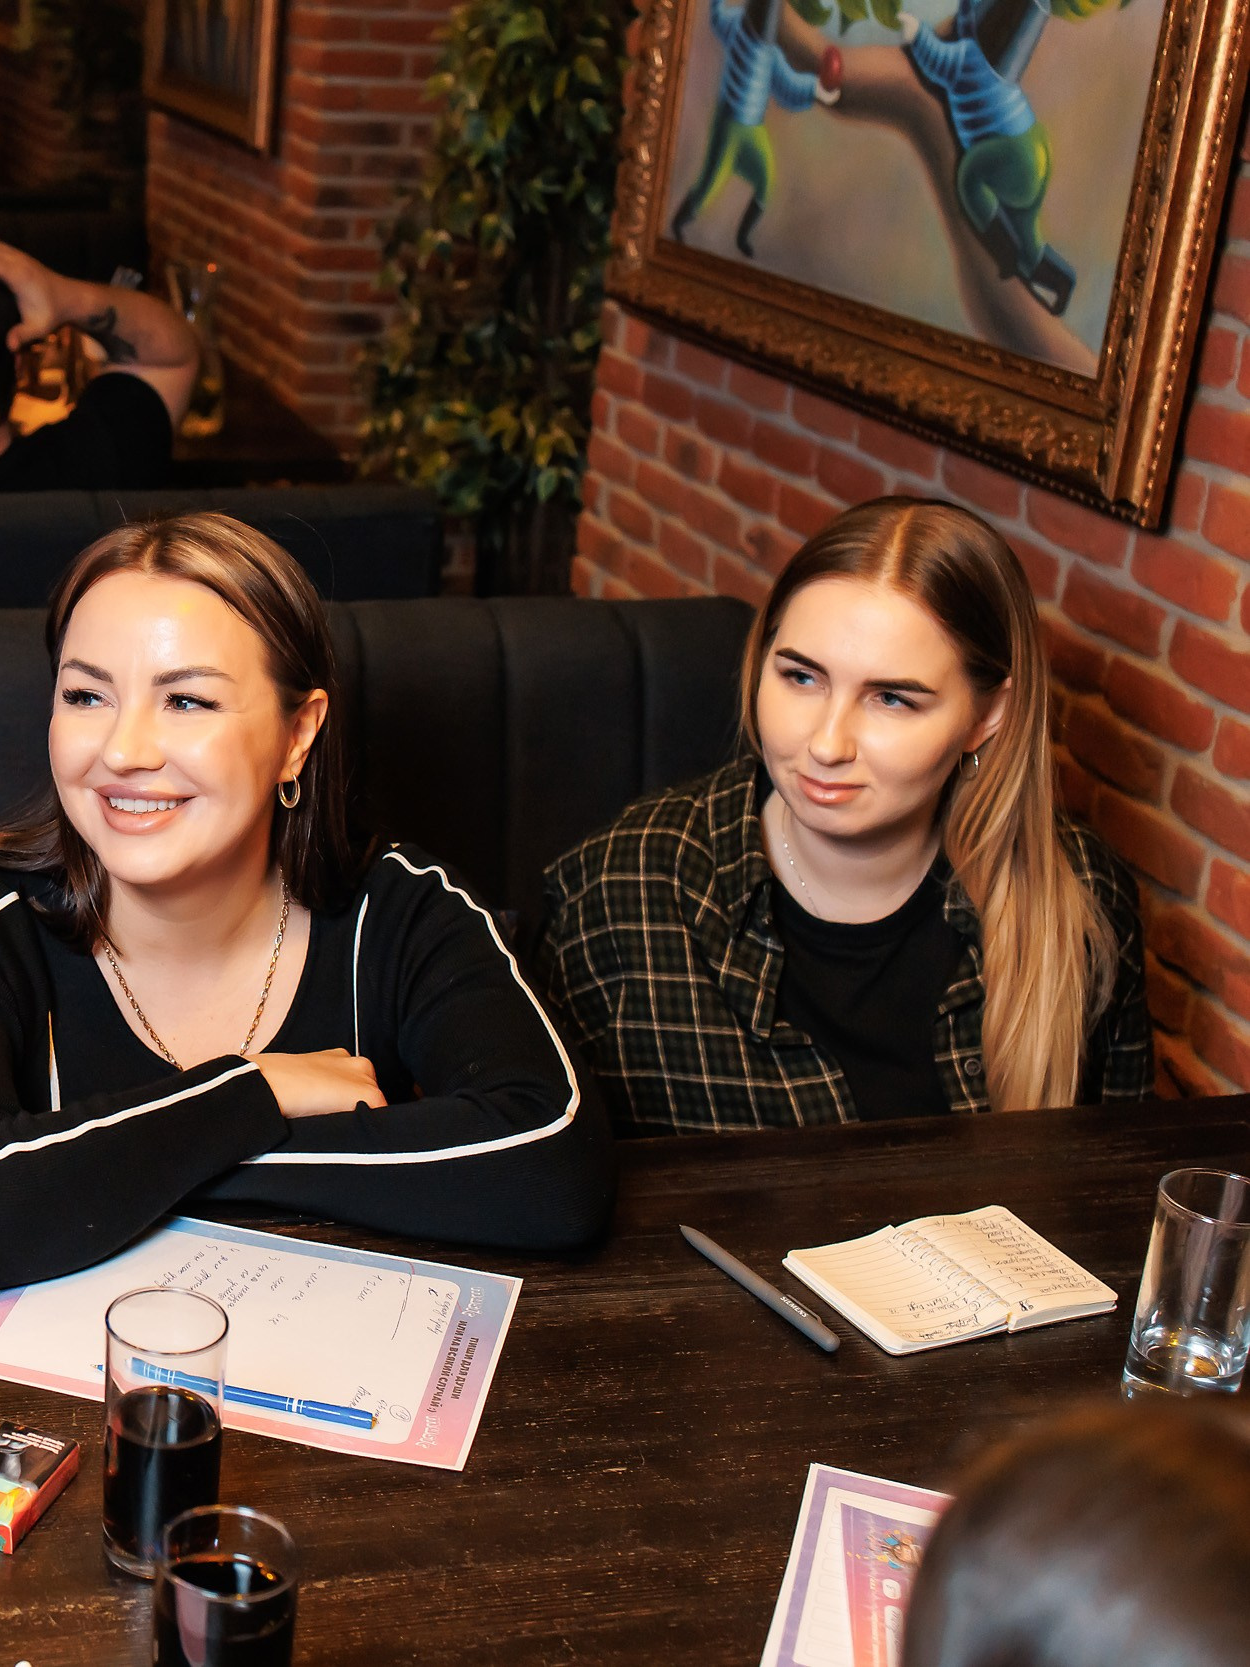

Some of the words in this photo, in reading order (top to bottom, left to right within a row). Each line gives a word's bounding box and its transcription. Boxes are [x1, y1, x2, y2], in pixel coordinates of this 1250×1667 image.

[780, 1296, 808, 1318] SIEMENS
[455, 1320, 468, 1336] ИЛИ
[450, 1336, 462, 1346] НА
[464, 1337, 480, 1360] ПИШИ
[440, 1346, 459, 1377] ВСЯКИЙ
[458, 1359, 471, 1376] ДЛЯ
[451, 1375, 466, 1400] ДУШИ
